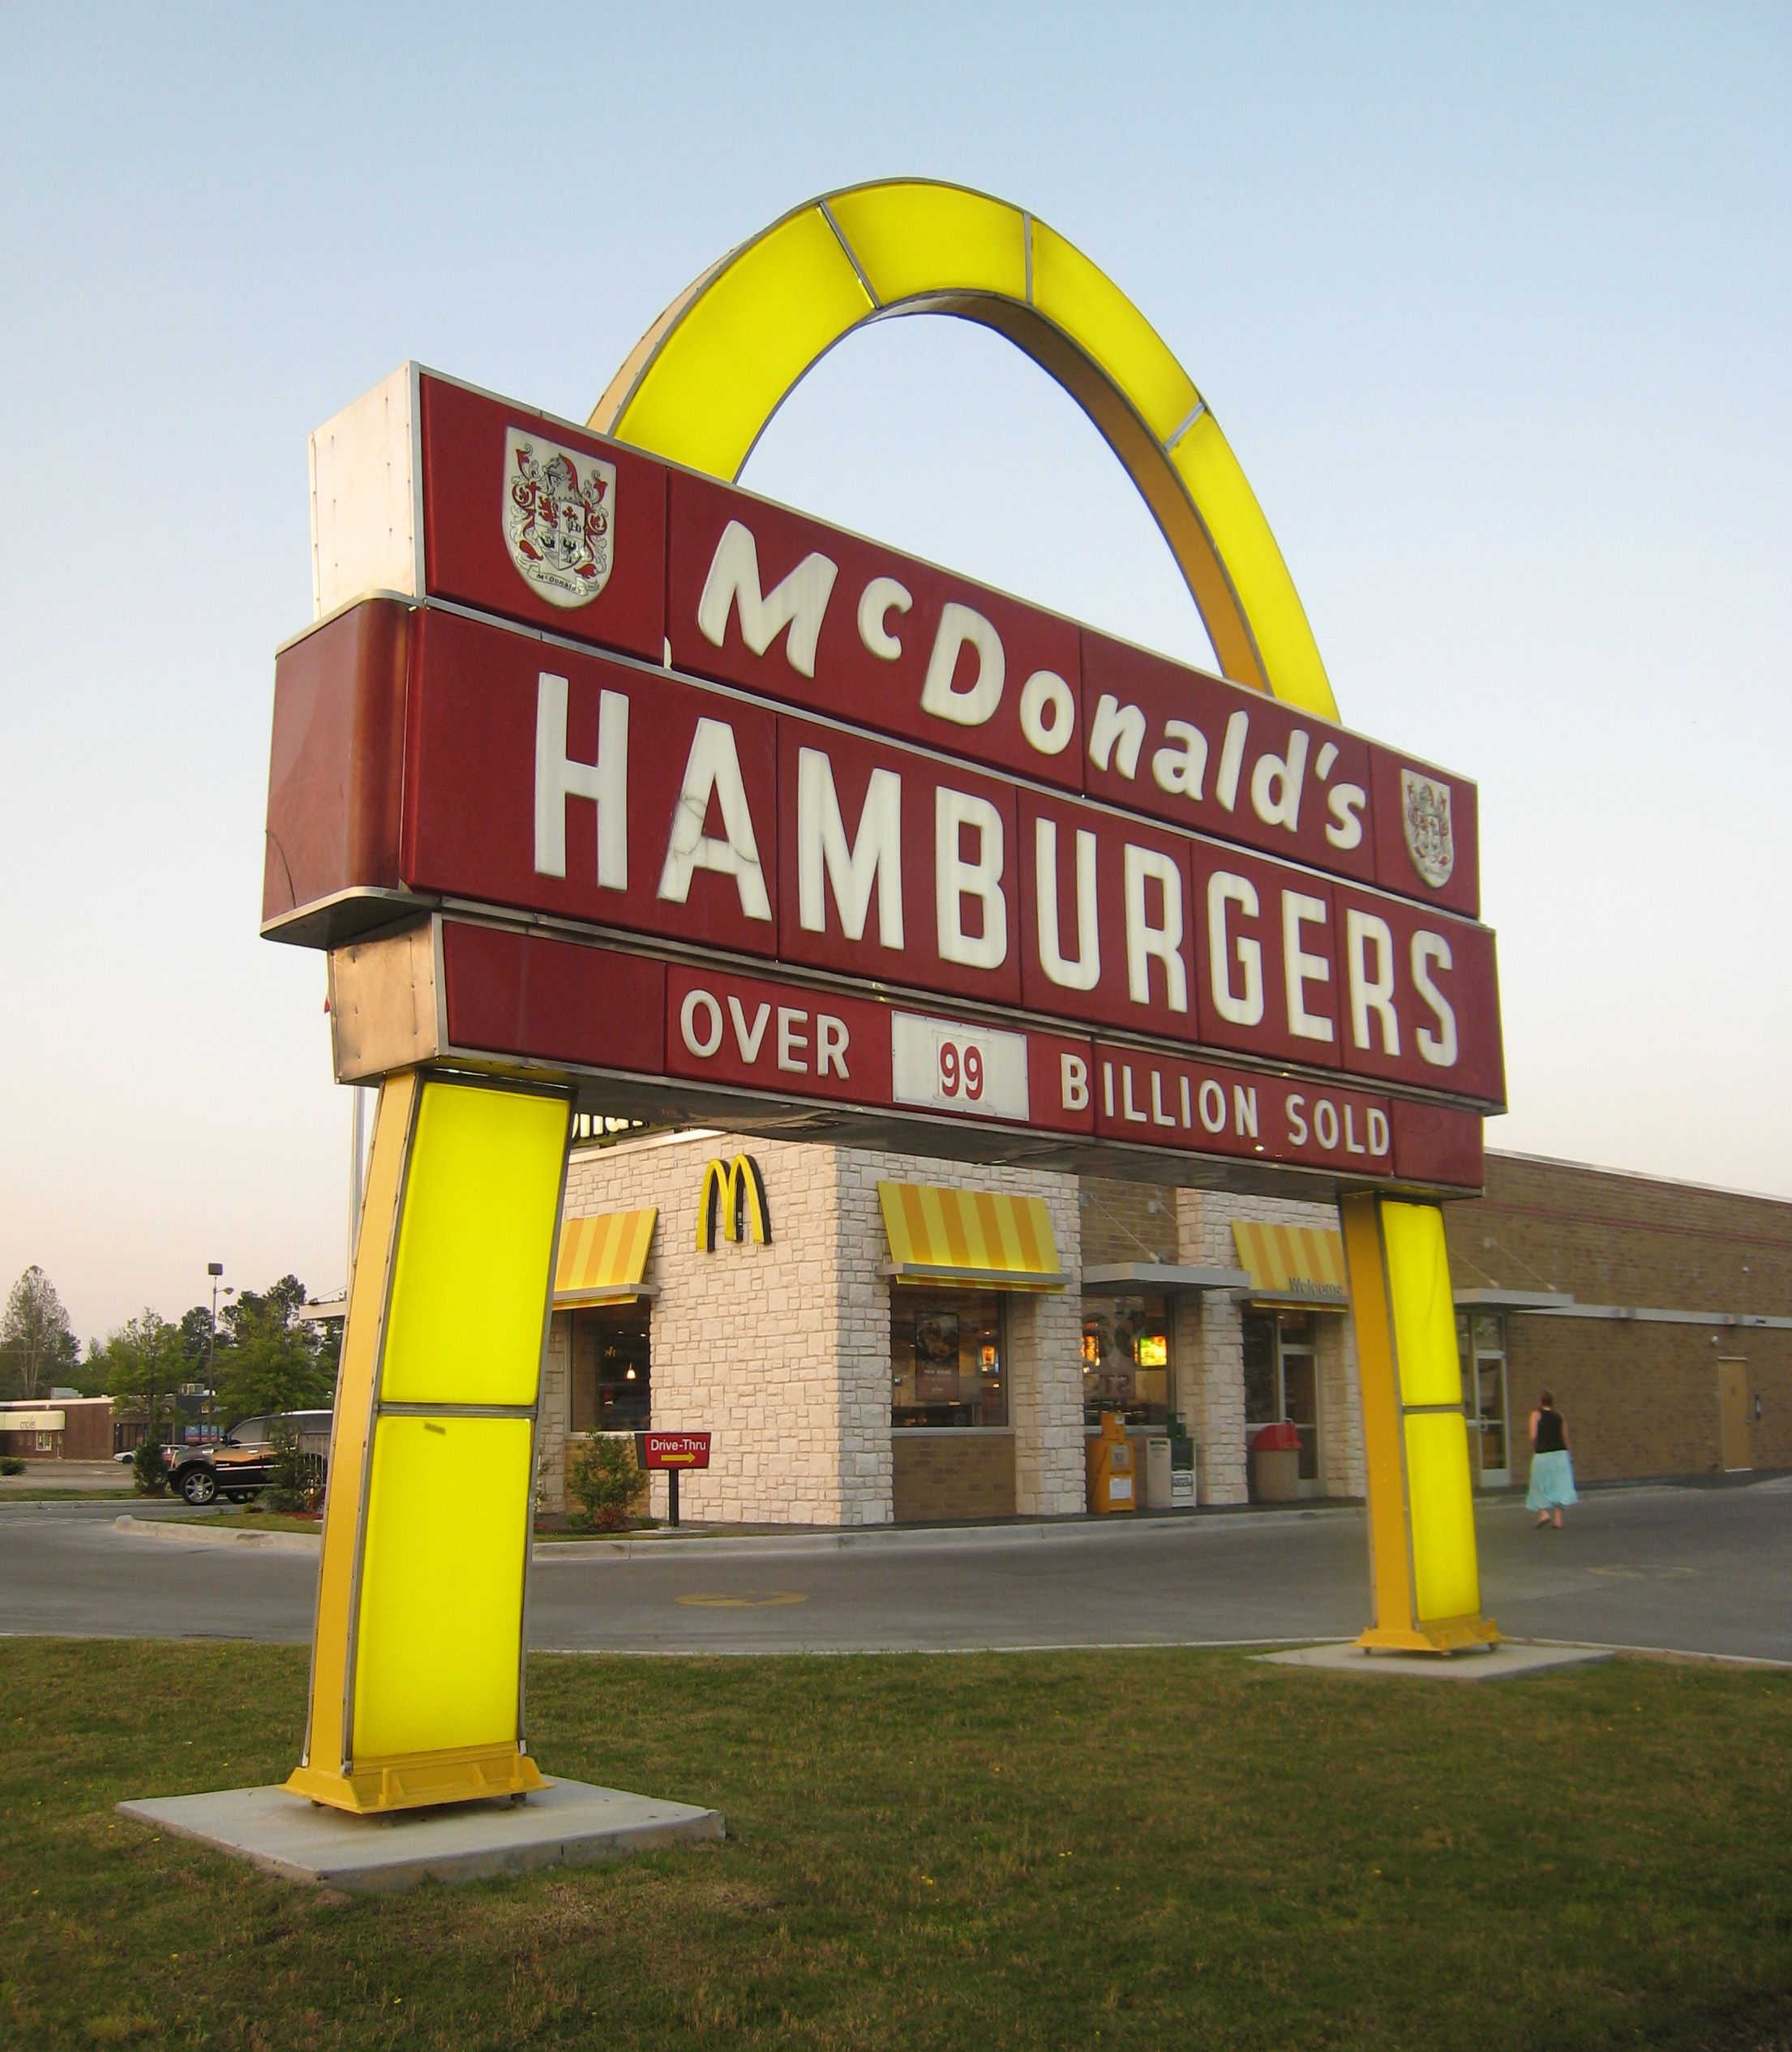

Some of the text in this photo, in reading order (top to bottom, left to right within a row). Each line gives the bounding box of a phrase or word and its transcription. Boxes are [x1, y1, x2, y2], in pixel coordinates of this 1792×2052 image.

[697, 519, 1366, 850] McDonald's
[533, 670, 1460, 1068] HAMBURGERS
[680, 989, 1390, 1157] OVER 99 BILLION SOLD
[1288, 1277, 1344, 1295] Welcome
[650, 1438, 706, 1451] Drive-Thru
